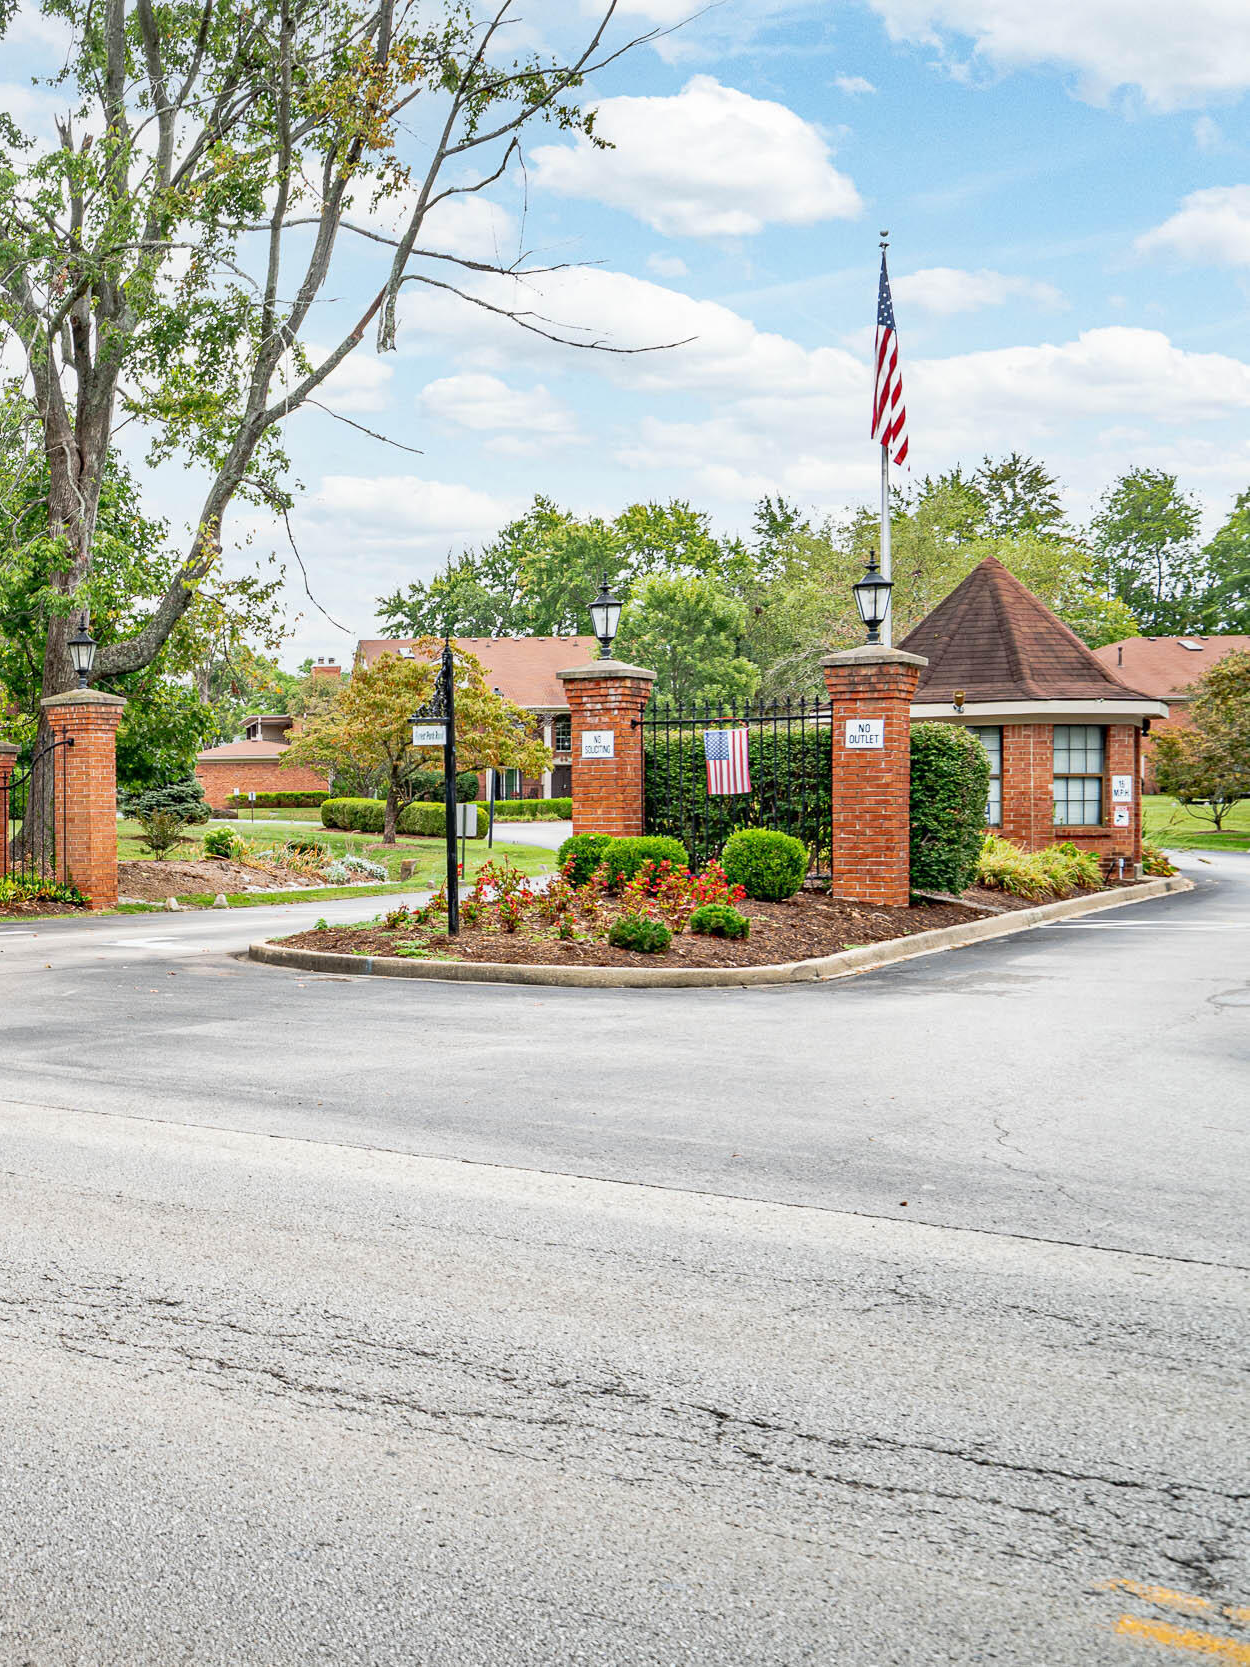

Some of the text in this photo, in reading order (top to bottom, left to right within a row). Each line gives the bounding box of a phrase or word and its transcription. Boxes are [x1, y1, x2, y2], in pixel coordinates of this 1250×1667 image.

[858, 723, 871, 733] NO
[593, 735, 602, 744] NO
[849, 734, 879, 744] OUTLET
[585, 745, 611, 754] SOLICITING
